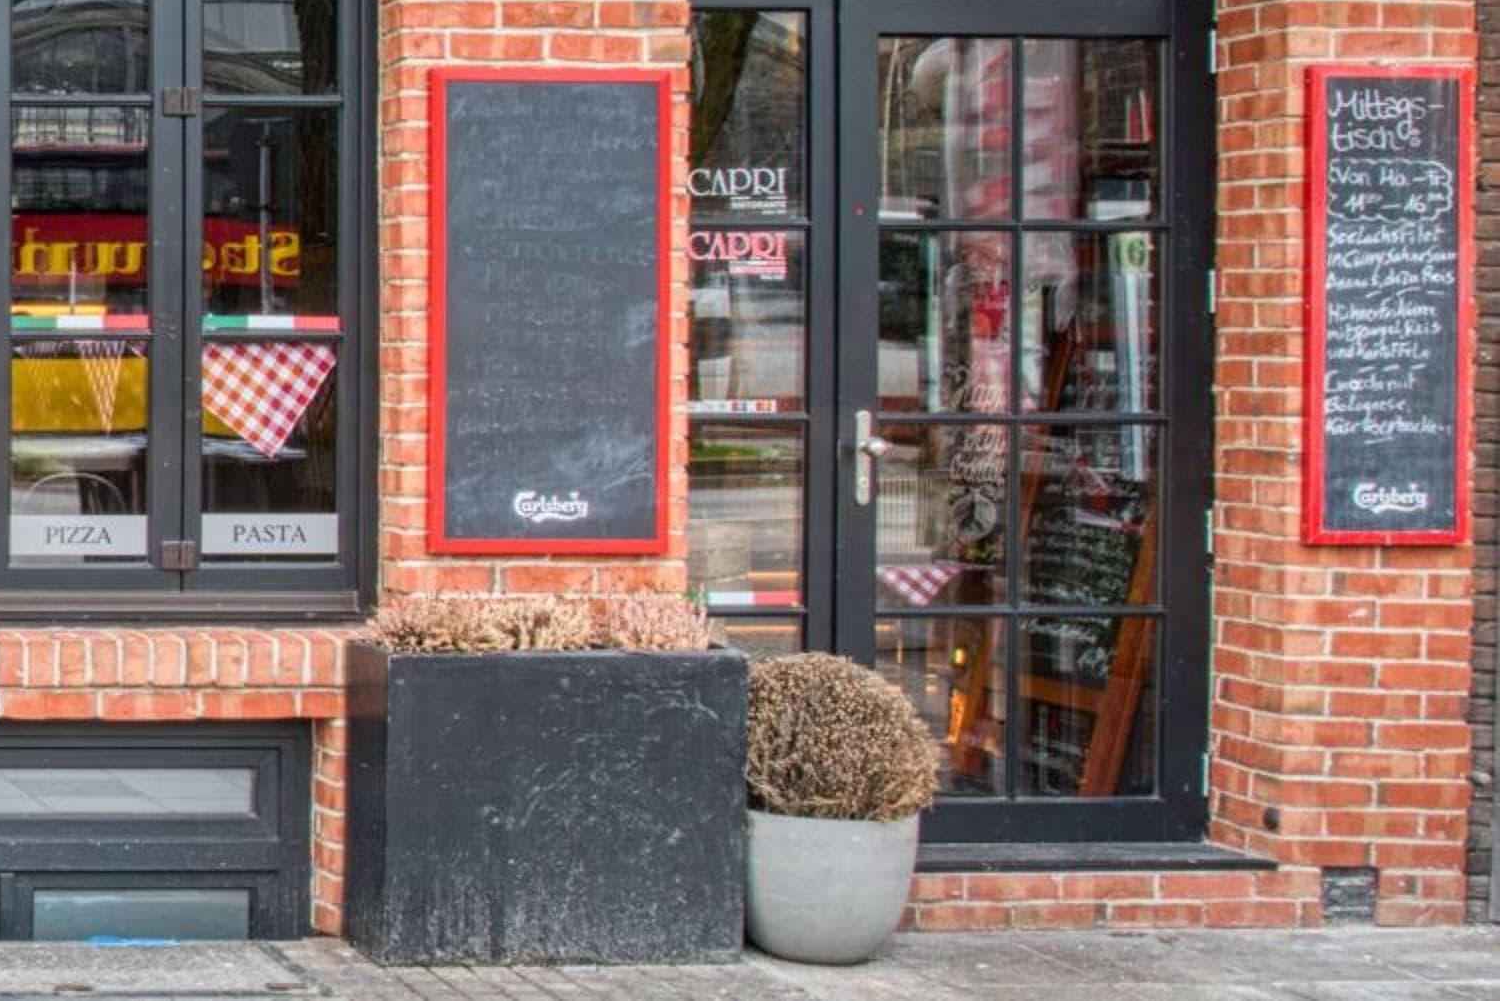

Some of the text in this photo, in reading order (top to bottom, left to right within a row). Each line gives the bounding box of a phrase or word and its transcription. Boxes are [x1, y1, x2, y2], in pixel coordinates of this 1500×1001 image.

[687, 167, 788, 197] CAPRI
[688, 231, 788, 260] CAPRI
[513, 490, 589, 523] Carlsberg
[1353, 482, 1428, 514] Carlsberg
[44, 524, 113, 545] PIZZA
[231, 524, 309, 545] PASTA
